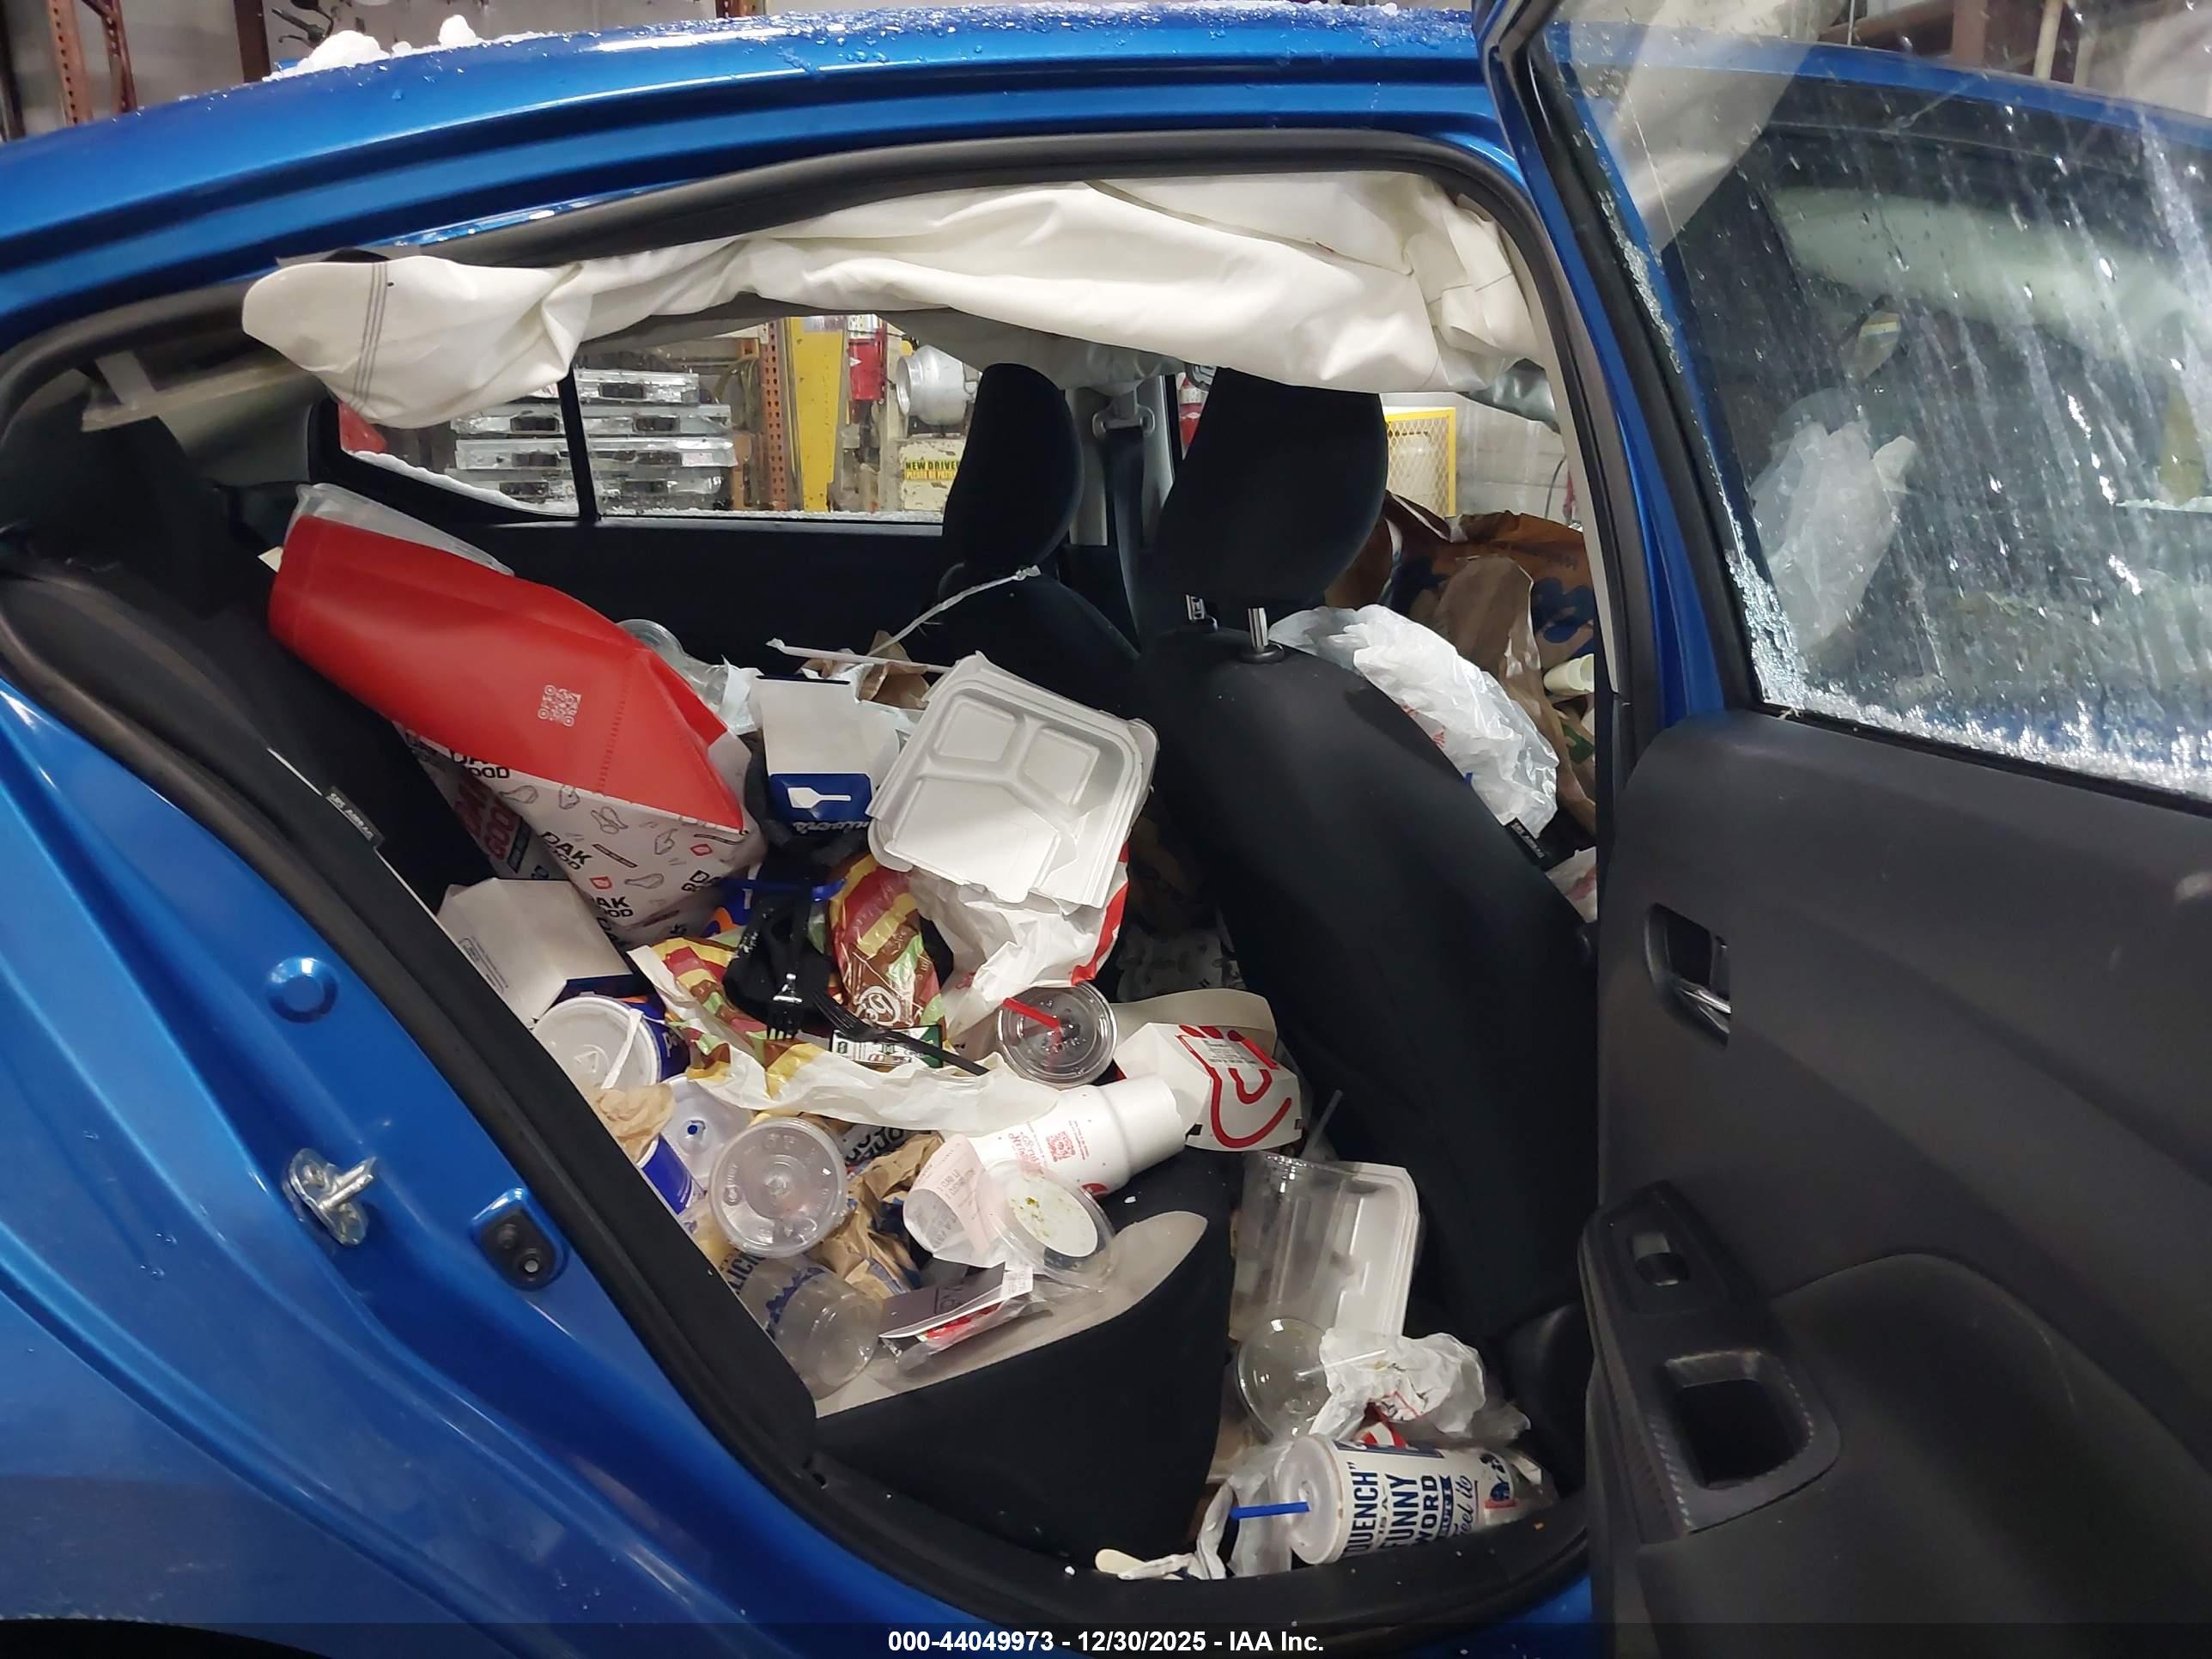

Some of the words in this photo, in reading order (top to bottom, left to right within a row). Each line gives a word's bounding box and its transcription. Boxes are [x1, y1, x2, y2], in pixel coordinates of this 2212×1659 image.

[906, 461, 926, 470] NEW
[344, 809, 374, 841] AIRBAG
[540, 831, 593, 866] DAK
[594, 896, 632, 908] AK
